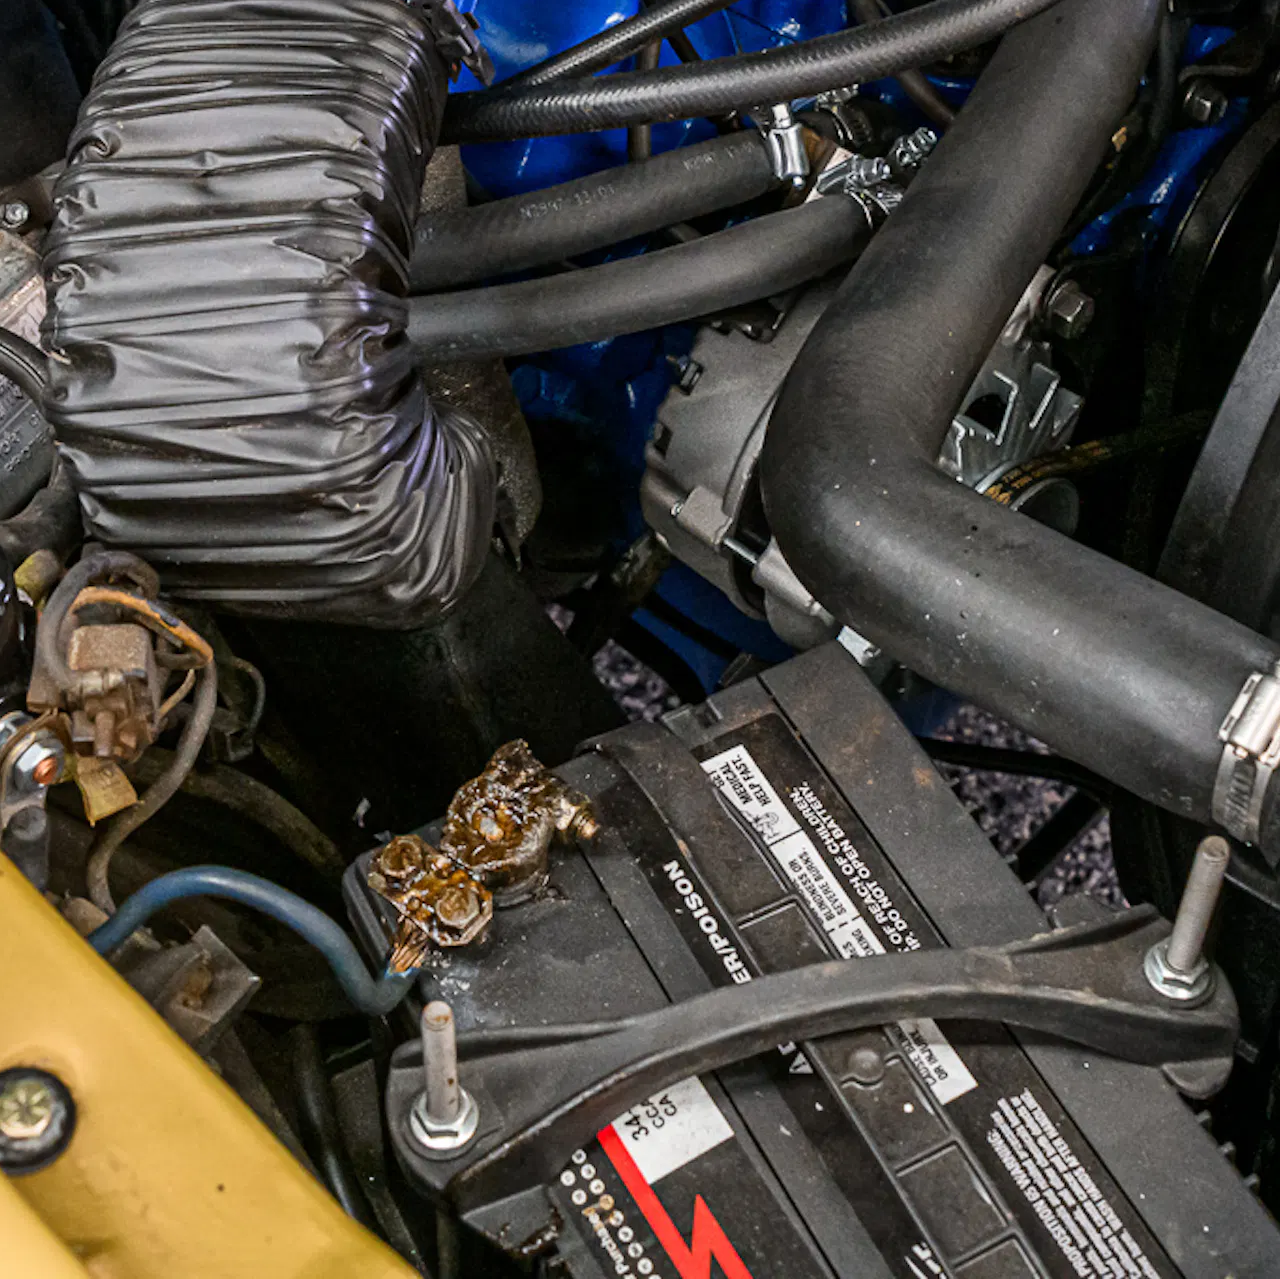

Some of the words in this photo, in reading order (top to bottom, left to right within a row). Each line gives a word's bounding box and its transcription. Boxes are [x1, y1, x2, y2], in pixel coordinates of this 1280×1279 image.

[717, 761, 753, 805] MEDICAL
[747, 781, 771, 806] HELP
[788, 785, 841, 855] CHILDREN.
[798, 779, 845, 839] BATTERY.
[787, 858, 803, 874] OR
[834, 853, 856, 877] OF
[838, 837, 872, 879] OPEN
[796, 871, 835, 921] BLINDNESS
[818, 880, 847, 916] SEVERE
[849, 874, 888, 924] REACH
[865, 878, 893, 909] NOT
[881, 921, 903, 946] OF
[886, 907, 908, 932] DO
[933, 1064, 949, 1081] OR
[656, 1093, 679, 1118] CA
